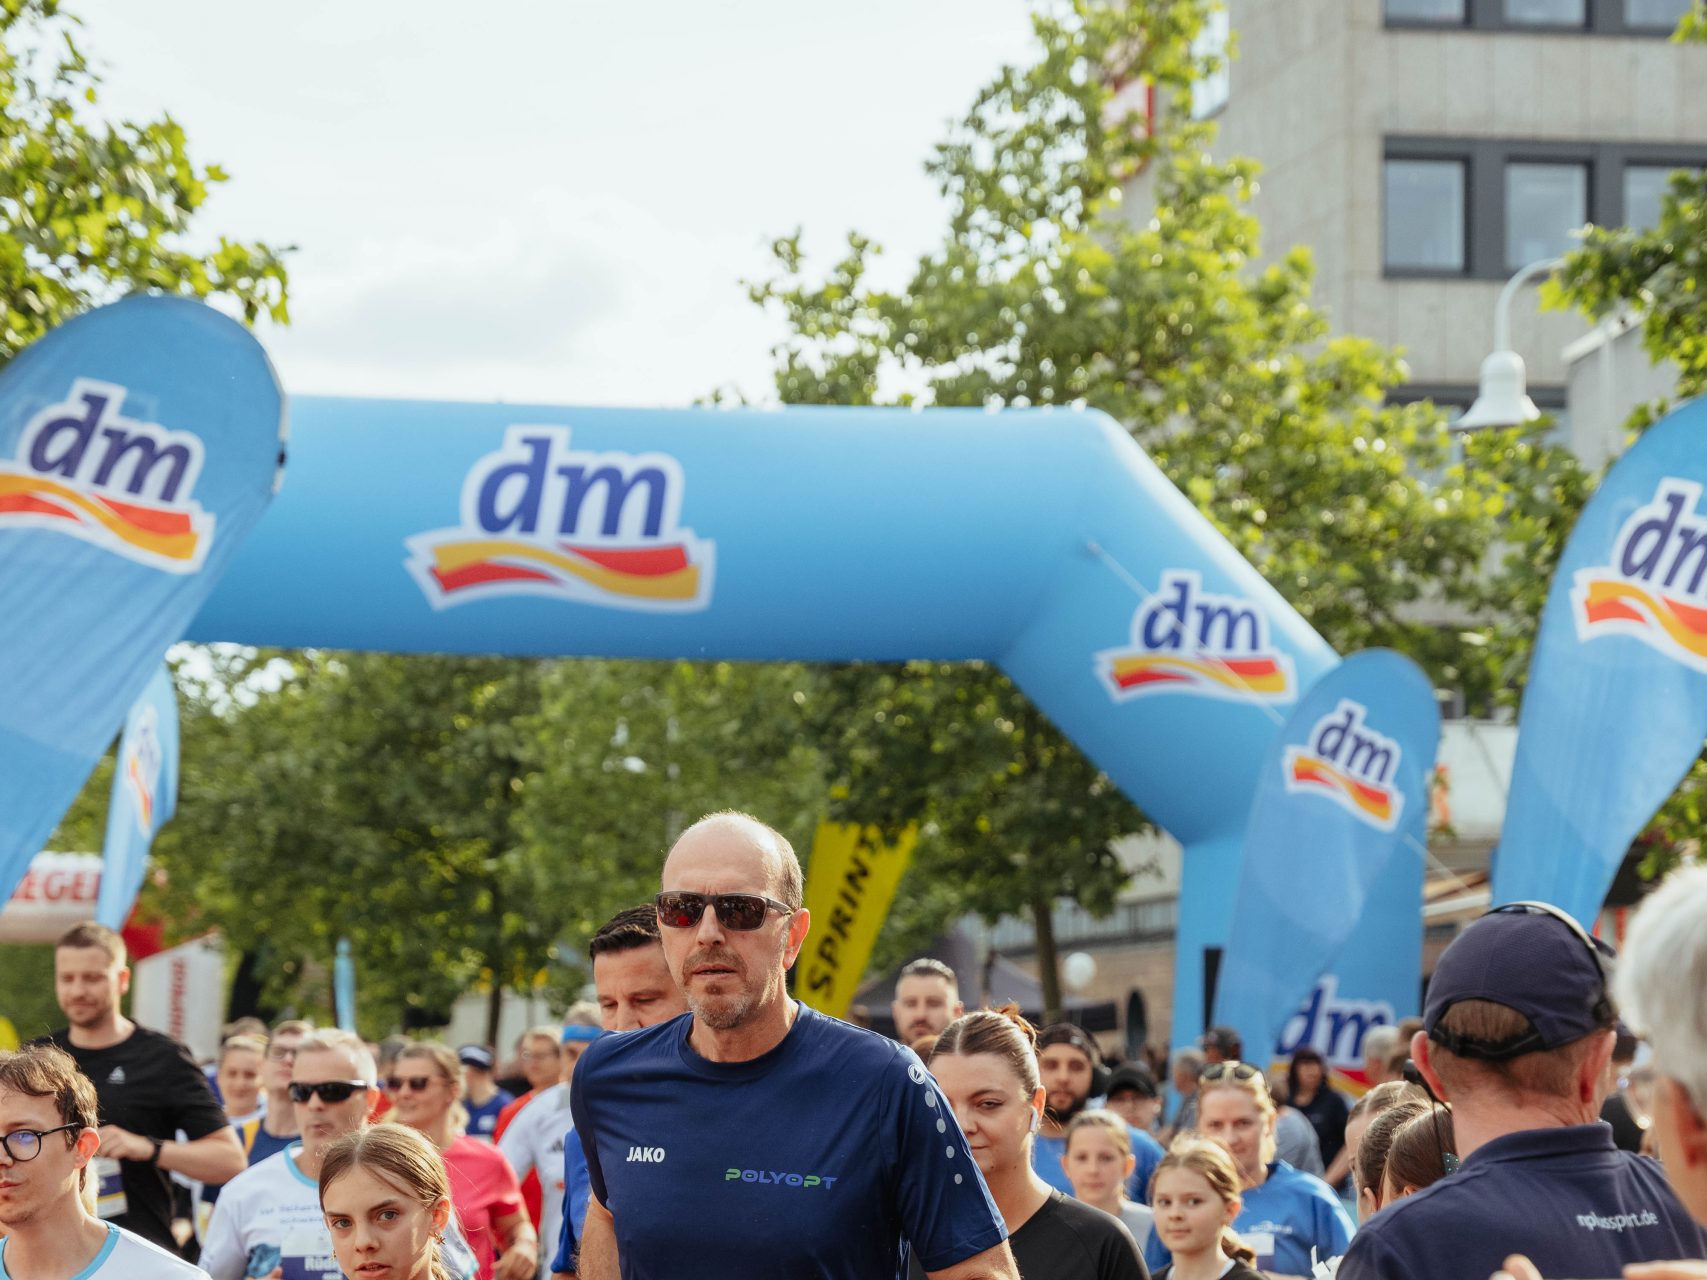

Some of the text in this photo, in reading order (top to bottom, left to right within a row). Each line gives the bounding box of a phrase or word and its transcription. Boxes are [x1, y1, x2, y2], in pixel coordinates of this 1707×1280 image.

[29, 393, 190, 502] dm
[477, 437, 668, 538] dm
[1142, 581, 1262, 651] dm
[1316, 710, 1391, 783] dm
[626, 1146, 666, 1163] JAKO
[725, 1168, 838, 1190] POLYOPT
